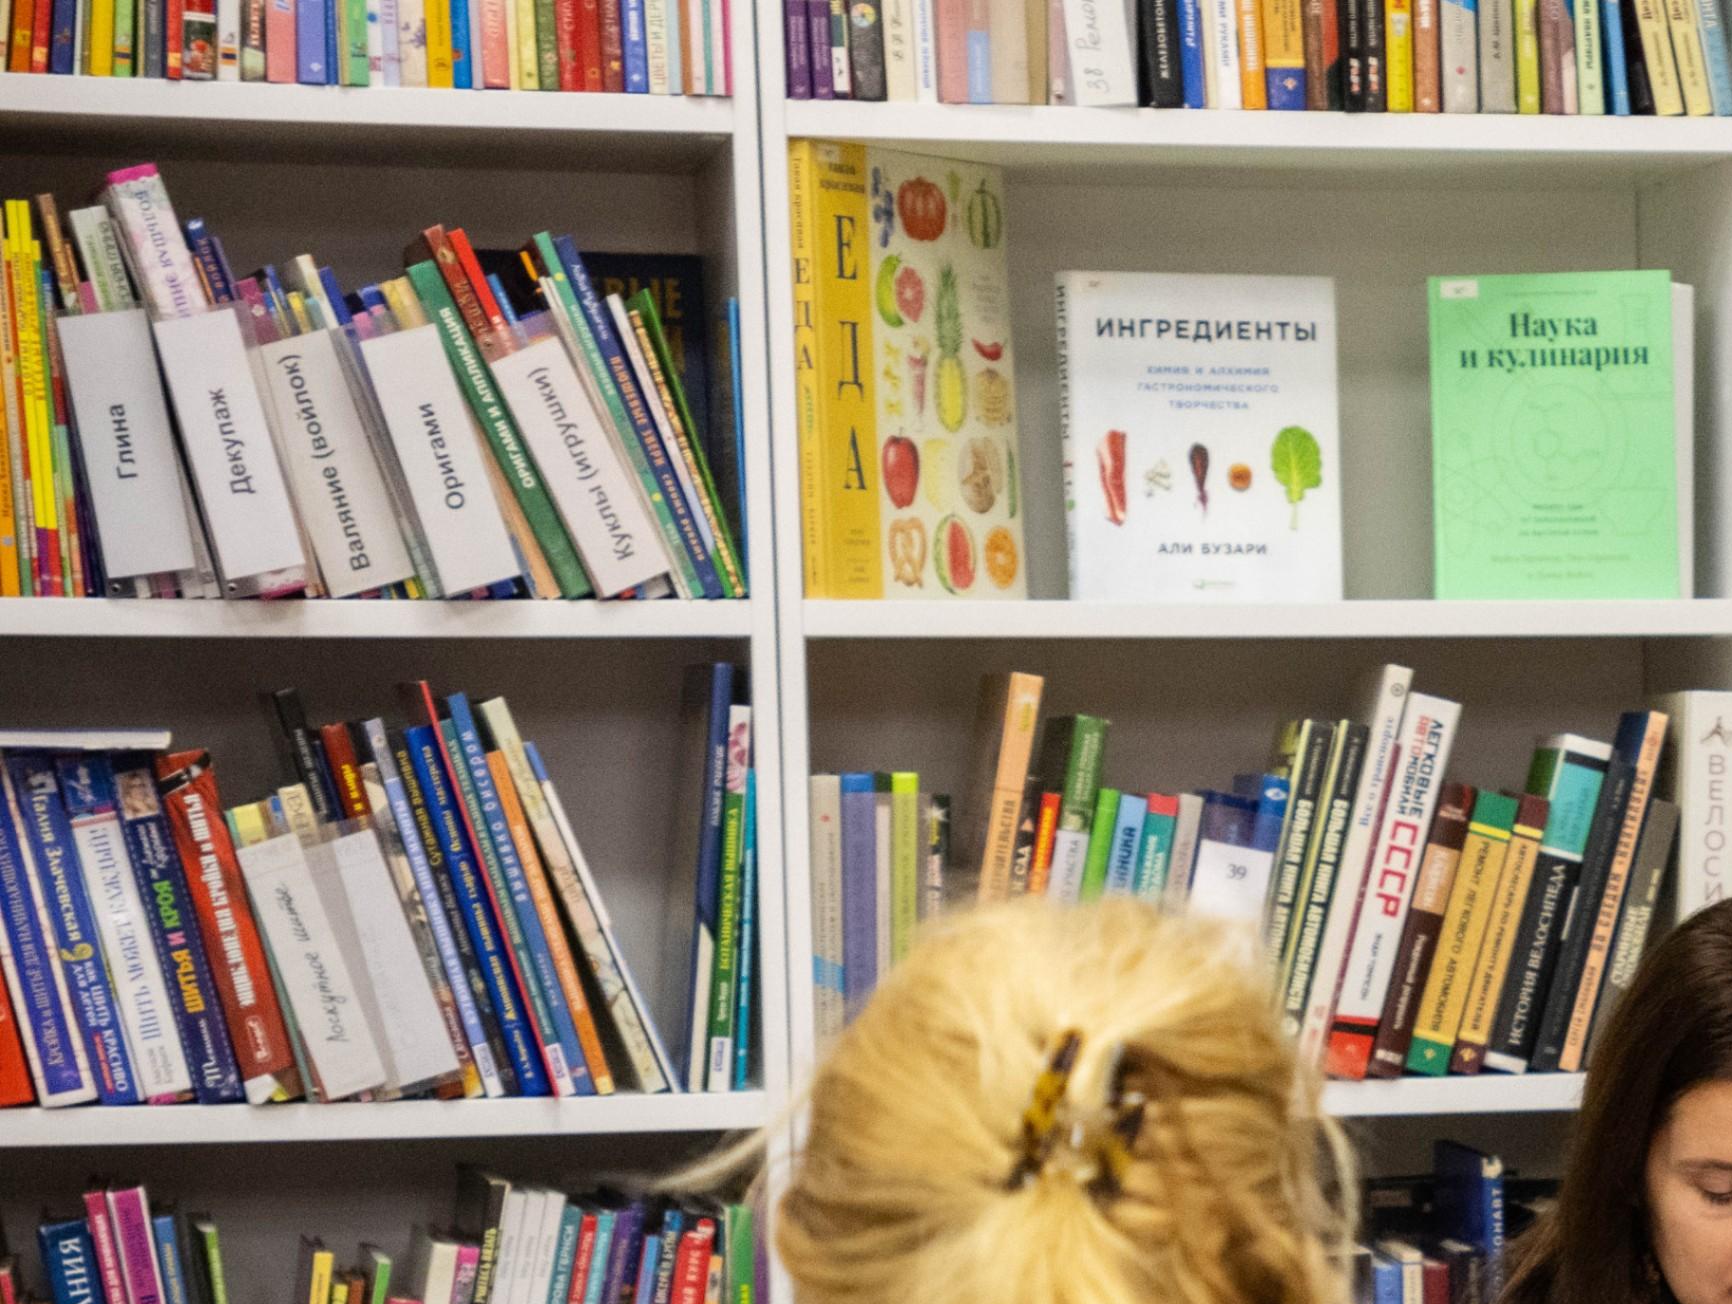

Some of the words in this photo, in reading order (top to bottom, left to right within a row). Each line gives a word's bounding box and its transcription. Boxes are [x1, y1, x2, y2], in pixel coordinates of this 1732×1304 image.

[439, 306, 497, 403] АППЛИКАЦИЯ
[1095, 317, 1319, 345] ИНГРЕДИЕНТЫ
[1507, 312, 1599, 341] Наука
[1136, 382, 1281, 395] ГАСТРОНОМИЧЕСКОГО
[1210, 365, 1271, 378] АЛХИМИЯ
[1459, 348, 1479, 369] и
[1486, 345, 1650, 373] кулинария
[278, 353, 335, 460] (войлок)
[486, 407, 503, 418] И
[527, 366, 598, 480] (игрушки)
[1169, 399, 1251, 412] ТВОРЧЕСТВА
[110, 403, 138, 480] Глина
[208, 387, 256, 495] Декупаж
[417, 402, 466, 510] Оригами
[494, 419, 537, 489] ОРИГАМИ
[321, 466, 371, 573] Валяние
[587, 484, 636, 561] Куклы
[1157, 542, 1194, 557] АЛИ
[1200, 542, 1269, 557] БУЗАРИ
[394, 748, 423, 806] вышивка
[1359, 803, 1374, 828] Все
[1367, 715, 1396, 789] транспорте
[1394, 714, 1429, 816] АВТОМОБИЛИ
[1407, 718, 1443, 819] ЛЕГКОВЫЕ
[412, 805, 444, 867] Сутажная
[1320, 798, 1349, 860] БОЛЬШАЯ
[1226, 862, 1248, 881] 39
[1311, 862, 1335, 902] КНИГА
[1375, 819, 1420, 918] СССР
[1466, 839, 1490, 885] РЕМОНТ
[153, 879, 182, 929] КРОЯ
[1449, 889, 1480, 954] ЛЕГКОВОГО
[113, 919, 148, 981] МОЖЕТ
[168, 931, 186, 946] И
[1506, 968, 1541, 1047] ИСТОРИЯ
[1525, 862, 1567, 970] ВЕЛОСИПЕДА
[132, 985, 162, 1041] ШИТЬ
[171, 949, 206, 1013] ШИТЬЯ
[306, 950, 350, 1043] Лоскутное
[1429, 958, 1461, 1032] АВТОМОБИЛЯ
[101, 1028, 128, 1092] КРАСИВО
